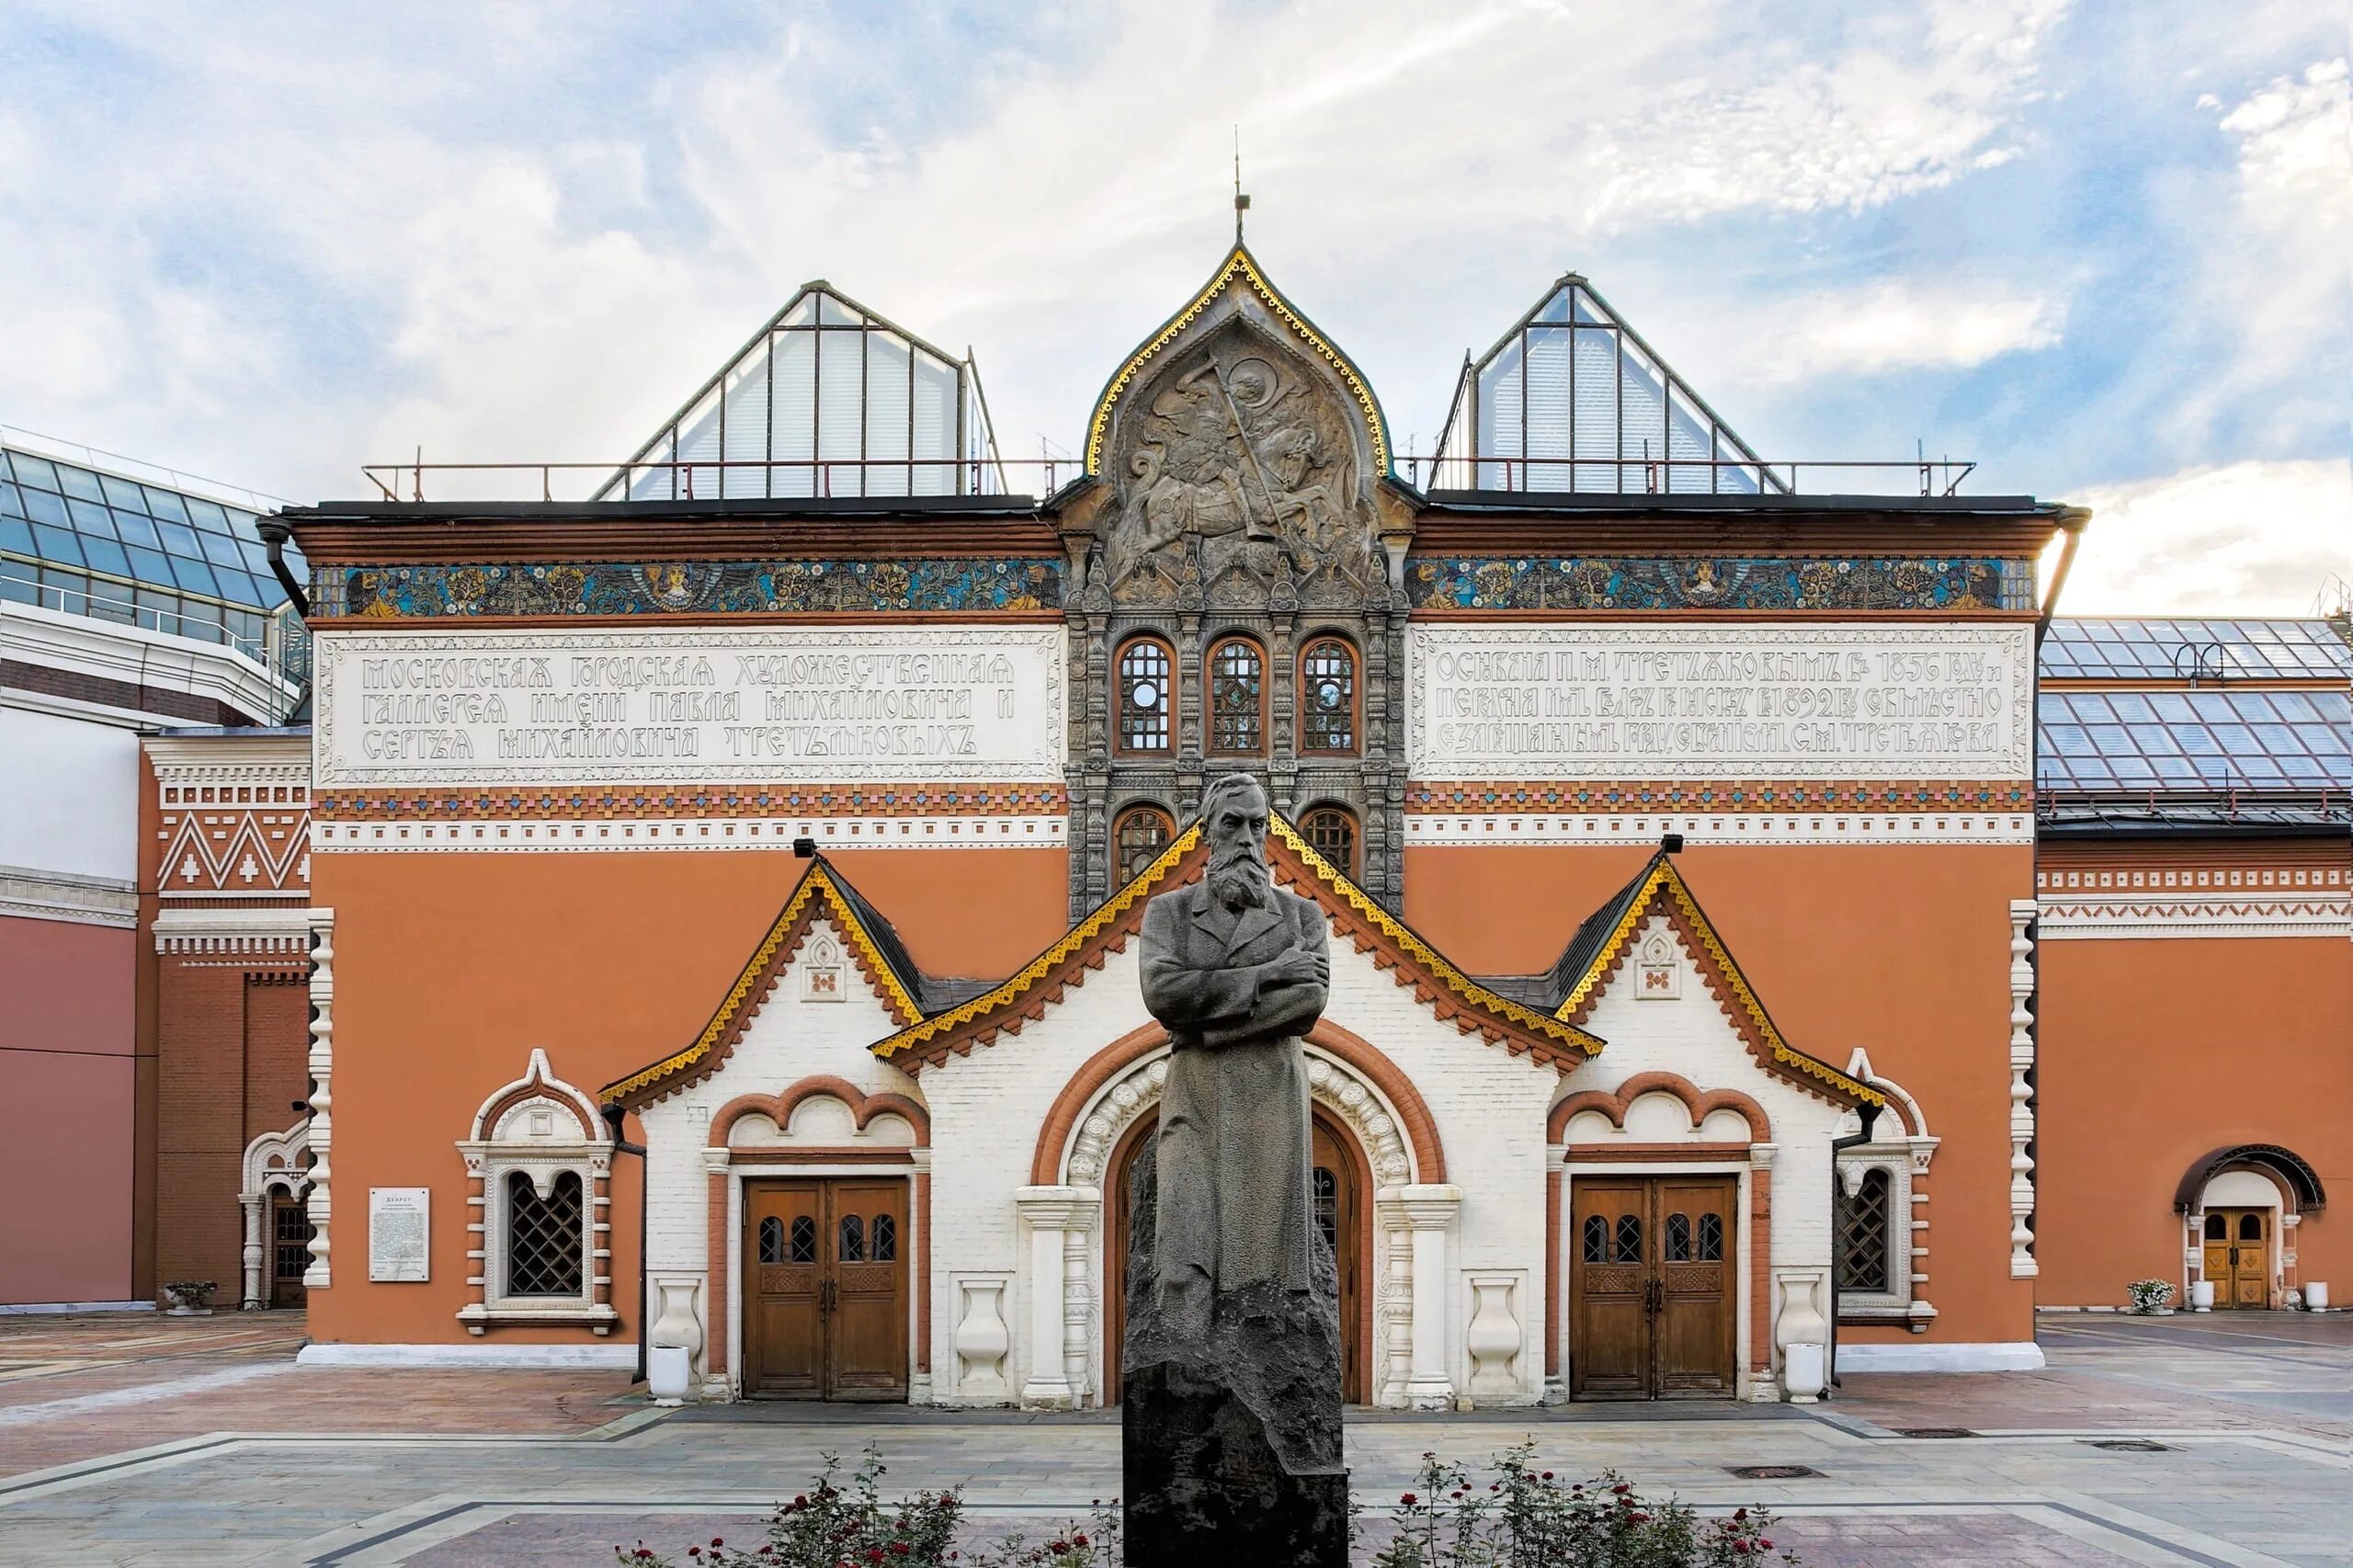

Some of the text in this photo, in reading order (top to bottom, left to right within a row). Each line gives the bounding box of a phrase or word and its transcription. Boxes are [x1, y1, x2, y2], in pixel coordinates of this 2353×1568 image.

[1875, 652, 1940, 681] 1856
[530, 692, 626, 722] ИМЕНИ
[650, 691, 740, 722] ПАВЛА
[765, 685, 972, 721] МИХАЙЛОВИЧА
[997, 689, 1015, 719] И
[1772, 687, 1834, 719] 1892
[498, 722, 699, 758] МИХАЙЛОВИЧА
